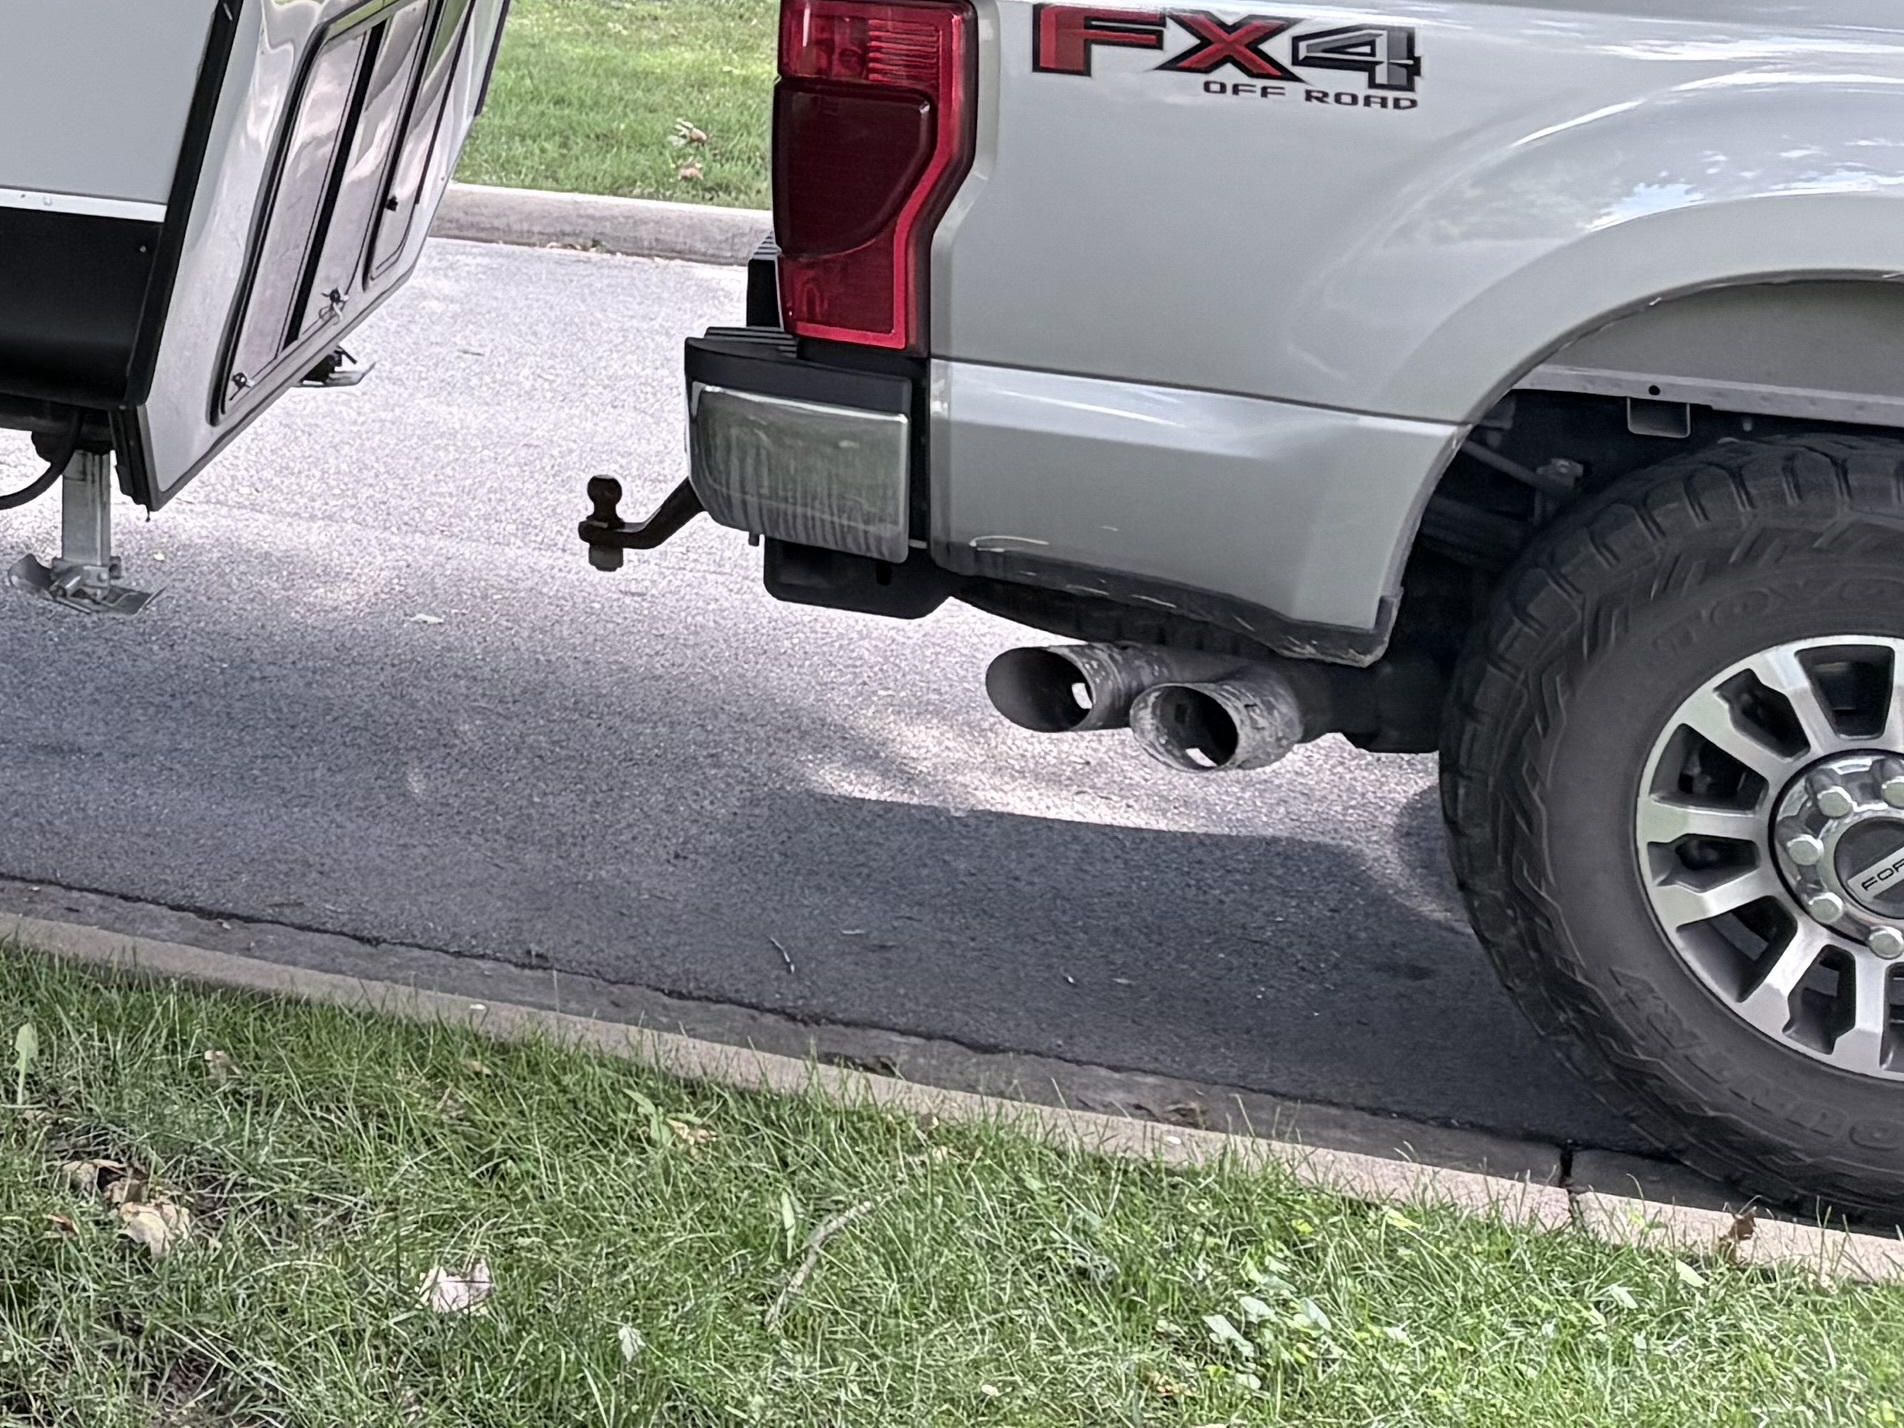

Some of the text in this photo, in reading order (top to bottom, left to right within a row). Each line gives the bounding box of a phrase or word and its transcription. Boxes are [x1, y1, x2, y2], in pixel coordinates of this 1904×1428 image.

[1032, 2, 1424, 93] FX4
[1203, 80, 1419, 111] OFF ROAD
